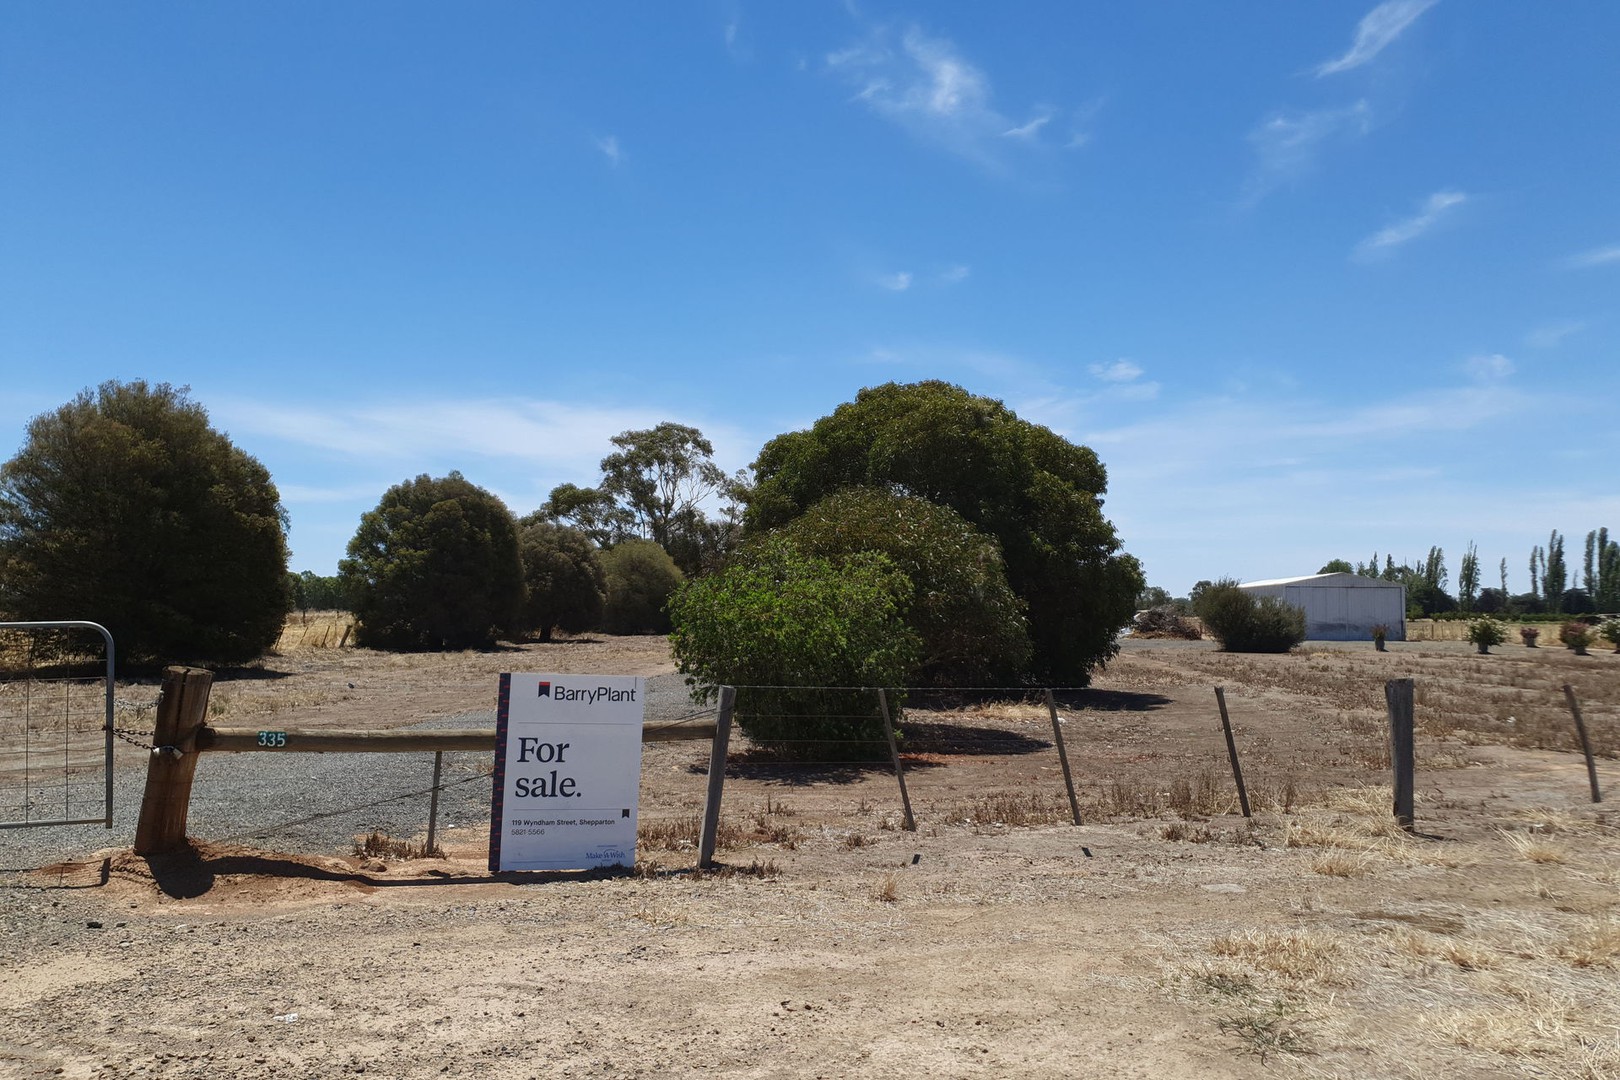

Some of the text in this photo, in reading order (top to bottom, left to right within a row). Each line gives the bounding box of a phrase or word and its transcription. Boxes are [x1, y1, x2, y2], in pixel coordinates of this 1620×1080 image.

[554, 685, 637, 705] BarryPlant
[257, 732, 286, 747] 335
[516, 737, 570, 763] For
[514, 770, 582, 798] sale.
[523, 819, 556, 827] Wyndham
[579, 819, 616, 827] Shepparton
[511, 828, 545, 836] 5821 5566
